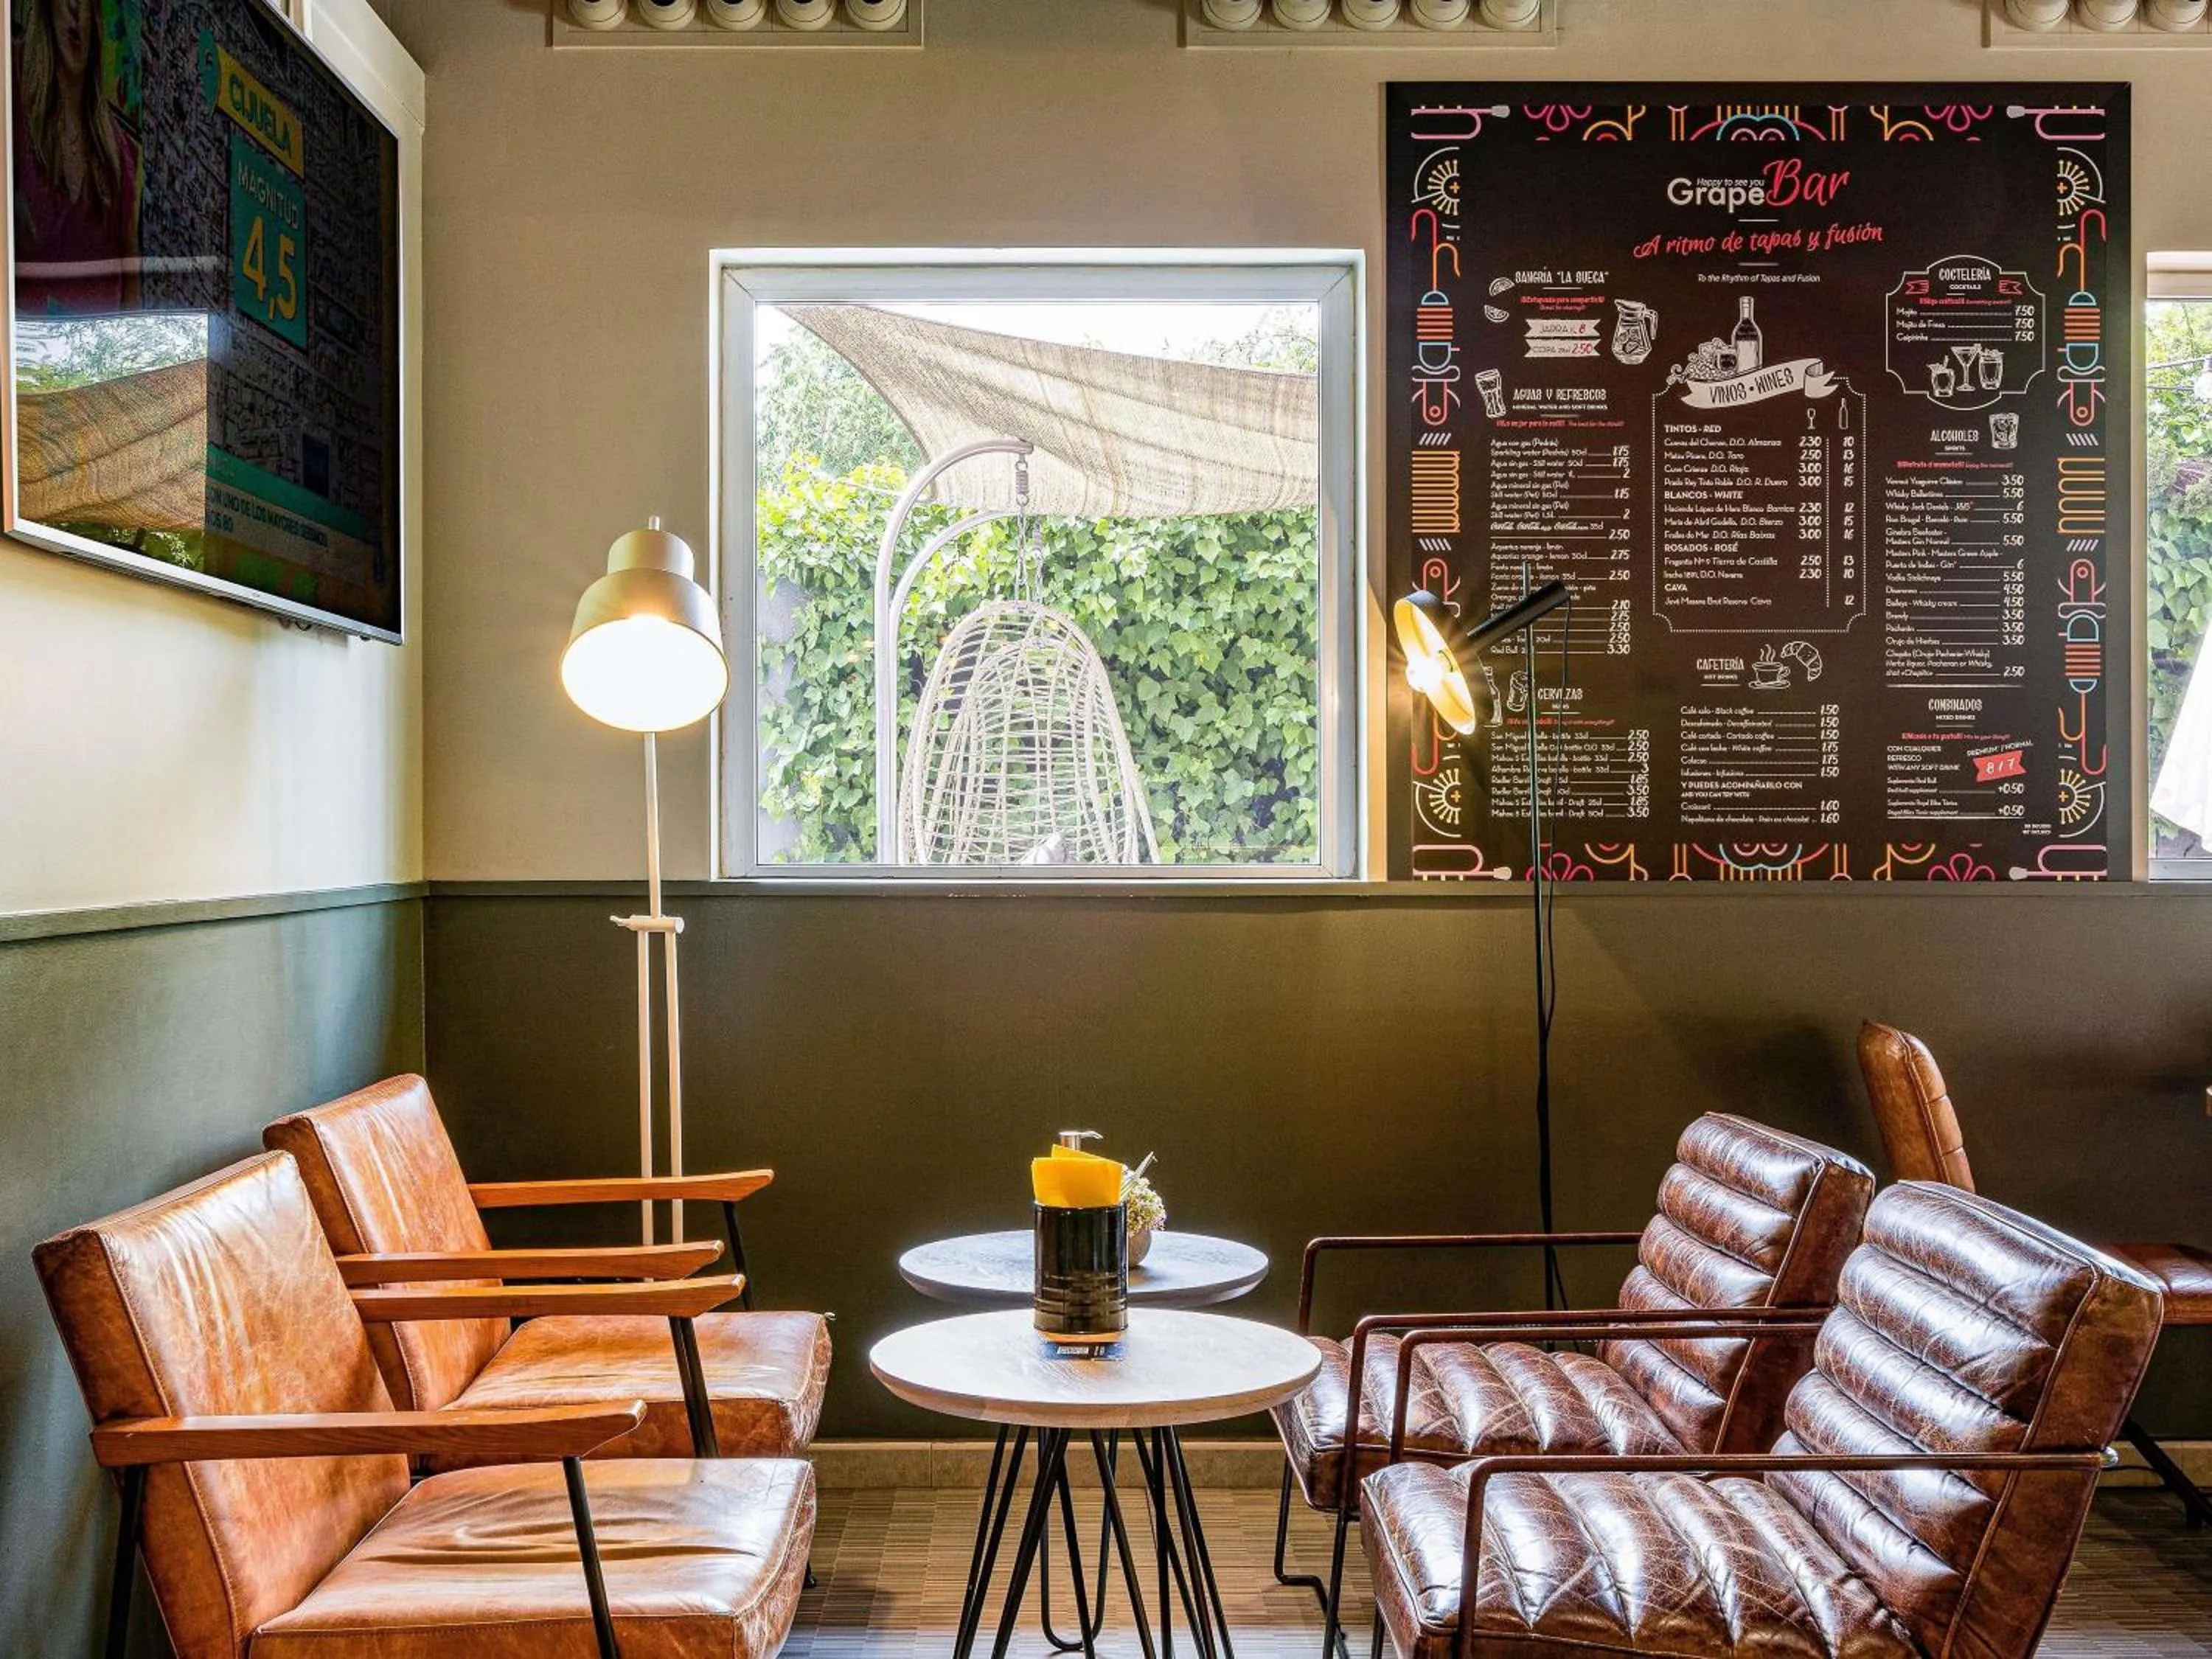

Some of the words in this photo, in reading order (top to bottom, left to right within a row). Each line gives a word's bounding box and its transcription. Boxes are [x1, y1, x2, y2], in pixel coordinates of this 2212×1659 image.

[229, 72, 293, 159] CIJUELA
[1667, 176, 1765, 213] Grape
[1762, 158, 1850, 206] Bar
[1749, 179, 1765, 188] you
[237, 160, 299, 229] MAGNITUD
[1633, 234, 1661, 258] A
[1666, 235, 1715, 255] ritmo
[1722, 231, 1744, 254] de
[1749, 230, 1801, 254] tapas
[1806, 230, 1821, 251] y
[1824, 222, 1883, 250] fusión
[243, 216, 297, 321] 4,5
[1939, 267, 1991, 280] COCTELERÍA
[1515, 267, 1552, 283] SANGRÍA
[1761, 274, 1782, 283] Tapas
[2015, 305, 2034, 316] 7.50
[2015, 319, 2034, 329] 7.50
[2015, 331, 2034, 341] 7.50
[1709, 383, 1747, 404] VINOS
[1753, 367, 1794, 394] WINES
[1513, 389, 1542, 400] AGUAS
[1557, 389, 1606, 400] REFRESCOS
[1930, 430, 1978, 442] ALCOHOLES
[1799, 437, 1821, 447] 2.30
[1843, 437, 1854, 447] 10
[1801, 450, 1821, 460] 2.50
[1843, 450, 1854, 460] 13
[1623, 468, 1630, 478] 2
[1799, 463, 1821, 473] 3.00
[1844, 463, 1854, 473] 16
[1799, 476, 1821, 487] 3.00
[1844, 476, 1854, 487] 15
[2002, 475, 2024, 485] 3.50
[2003, 488, 2024, 498] 5.50
[1799, 503, 1821, 513] 2.30
[1845, 503, 1854, 512] 12
[2017, 501, 2023, 510] 6
[1624, 509, 1630, 519] 2
[2003, 513, 2023, 524] 5.50
[1799, 516, 1821, 526] 3.00
[1844, 515, 1854, 526] 15
[1609, 529, 1630, 540] 2.50
[1799, 529, 1821, 539] 3.00
[1844, 529, 1854, 540] 16
[2003, 535, 2024, 546] 5.50
[1714, 541, 1738, 552] ROSÉ
[1801, 555, 1821, 566] 2.50
[1843, 555, 1854, 566] 13
[2017, 559, 2024, 569] 6
[1609, 570, 1630, 580] 2.50
[1799, 568, 1821, 579] 2.30
[1843, 568, 1854, 578] 10
[2003, 571, 2024, 582] 5.50
[2004, 584, 2024, 594] 4.50
[1845, 595, 1854, 605] 12
[2004, 597, 2024, 607] 4.50
[2003, 609, 2025, 619] 3.50
[1610, 622, 1630, 633] 2.50
[2003, 622, 2024, 633] 3.50
[1610, 632, 1630, 643] 2.50
[2003, 634, 2025, 644] 3.50
[1607, 644, 1630, 654] 3.30
[1697, 657, 1745, 670] CAFETERÍA
[2004, 667, 2025, 677] 2.50
[1821, 704, 1839, 715] 1.50
[1929, 699, 1982, 711] COMBINADOS
[1821, 717, 1839, 727] 1.50
[1628, 730, 1649, 740] 2.50
[1820, 729, 1839, 740] 1.50
[1628, 740, 1649, 751] 2.50
[1628, 752, 1649, 763] 2.50
[1641, 762, 1649, 773] 3
[1986, 762, 1994, 774] 8
[2006, 758, 2015, 770] 7
[1821, 767, 1839, 777] 1.50
[1627, 785, 1649, 795] 3.50
[1721, 780, 1782, 789] ACOMPAÑARLO
[1821, 800, 1839, 811] 1.60
[1627, 807, 1649, 817] 3.50
[1821, 813, 1839, 823] 1.60
